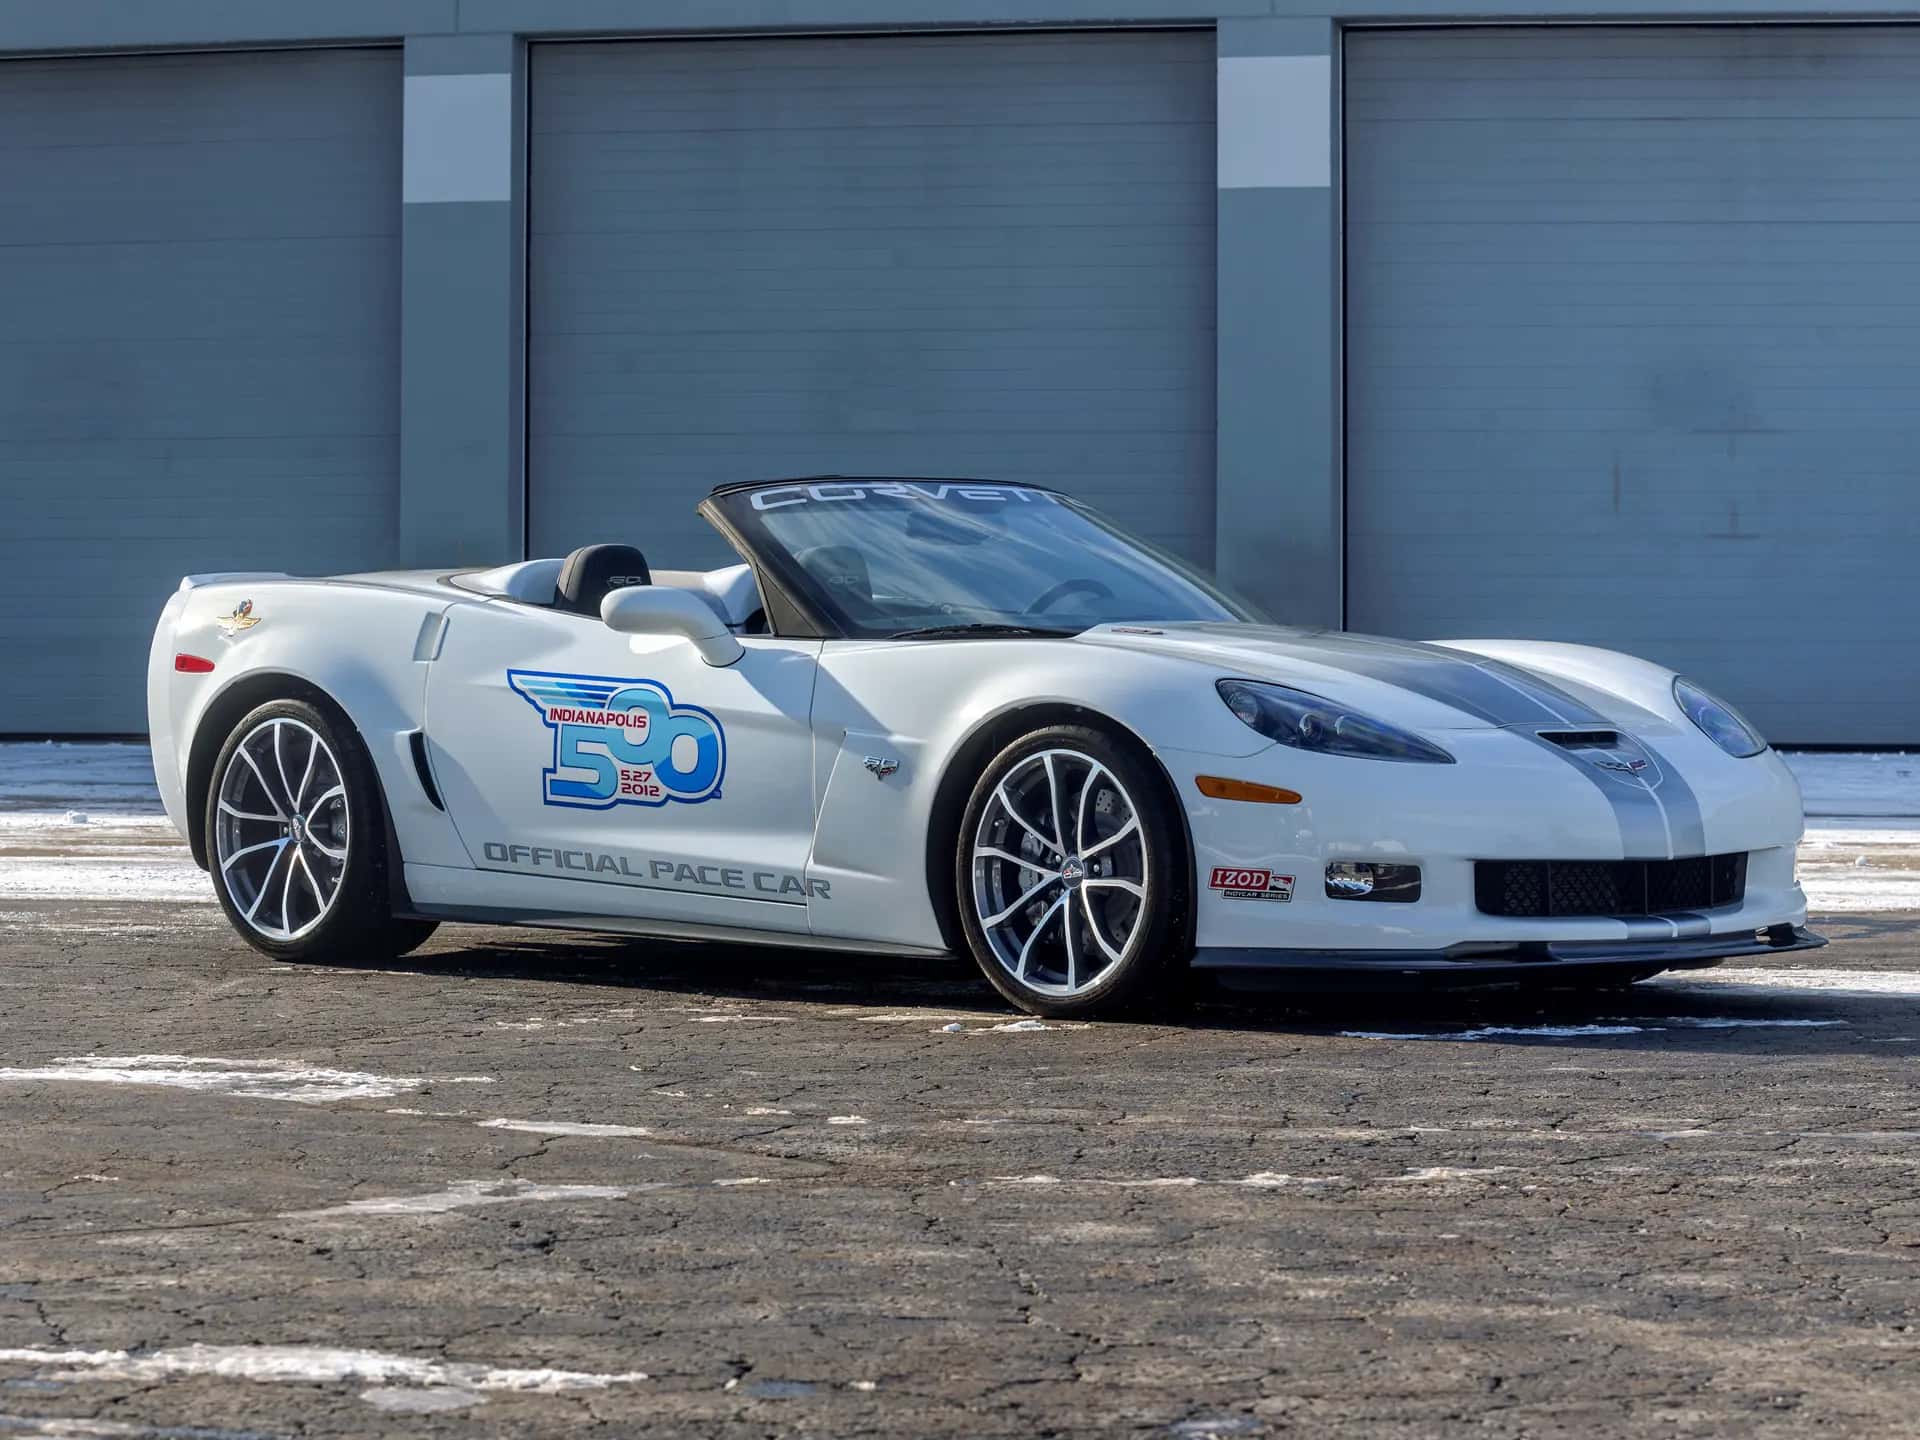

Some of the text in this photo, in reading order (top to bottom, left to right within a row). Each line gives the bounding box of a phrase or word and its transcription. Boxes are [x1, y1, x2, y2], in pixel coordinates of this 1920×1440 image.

[550, 708, 647, 728] INDIANAPOLIS
[549, 688, 719, 800] 500
[620, 769, 652, 782] 5.27
[621, 783, 660, 797] 2012
[484, 842, 831, 900] OFFICIAL PACE CAR
[1214, 870, 1266, 887] IZOD
[1261, 891, 1288, 899] SERIES
